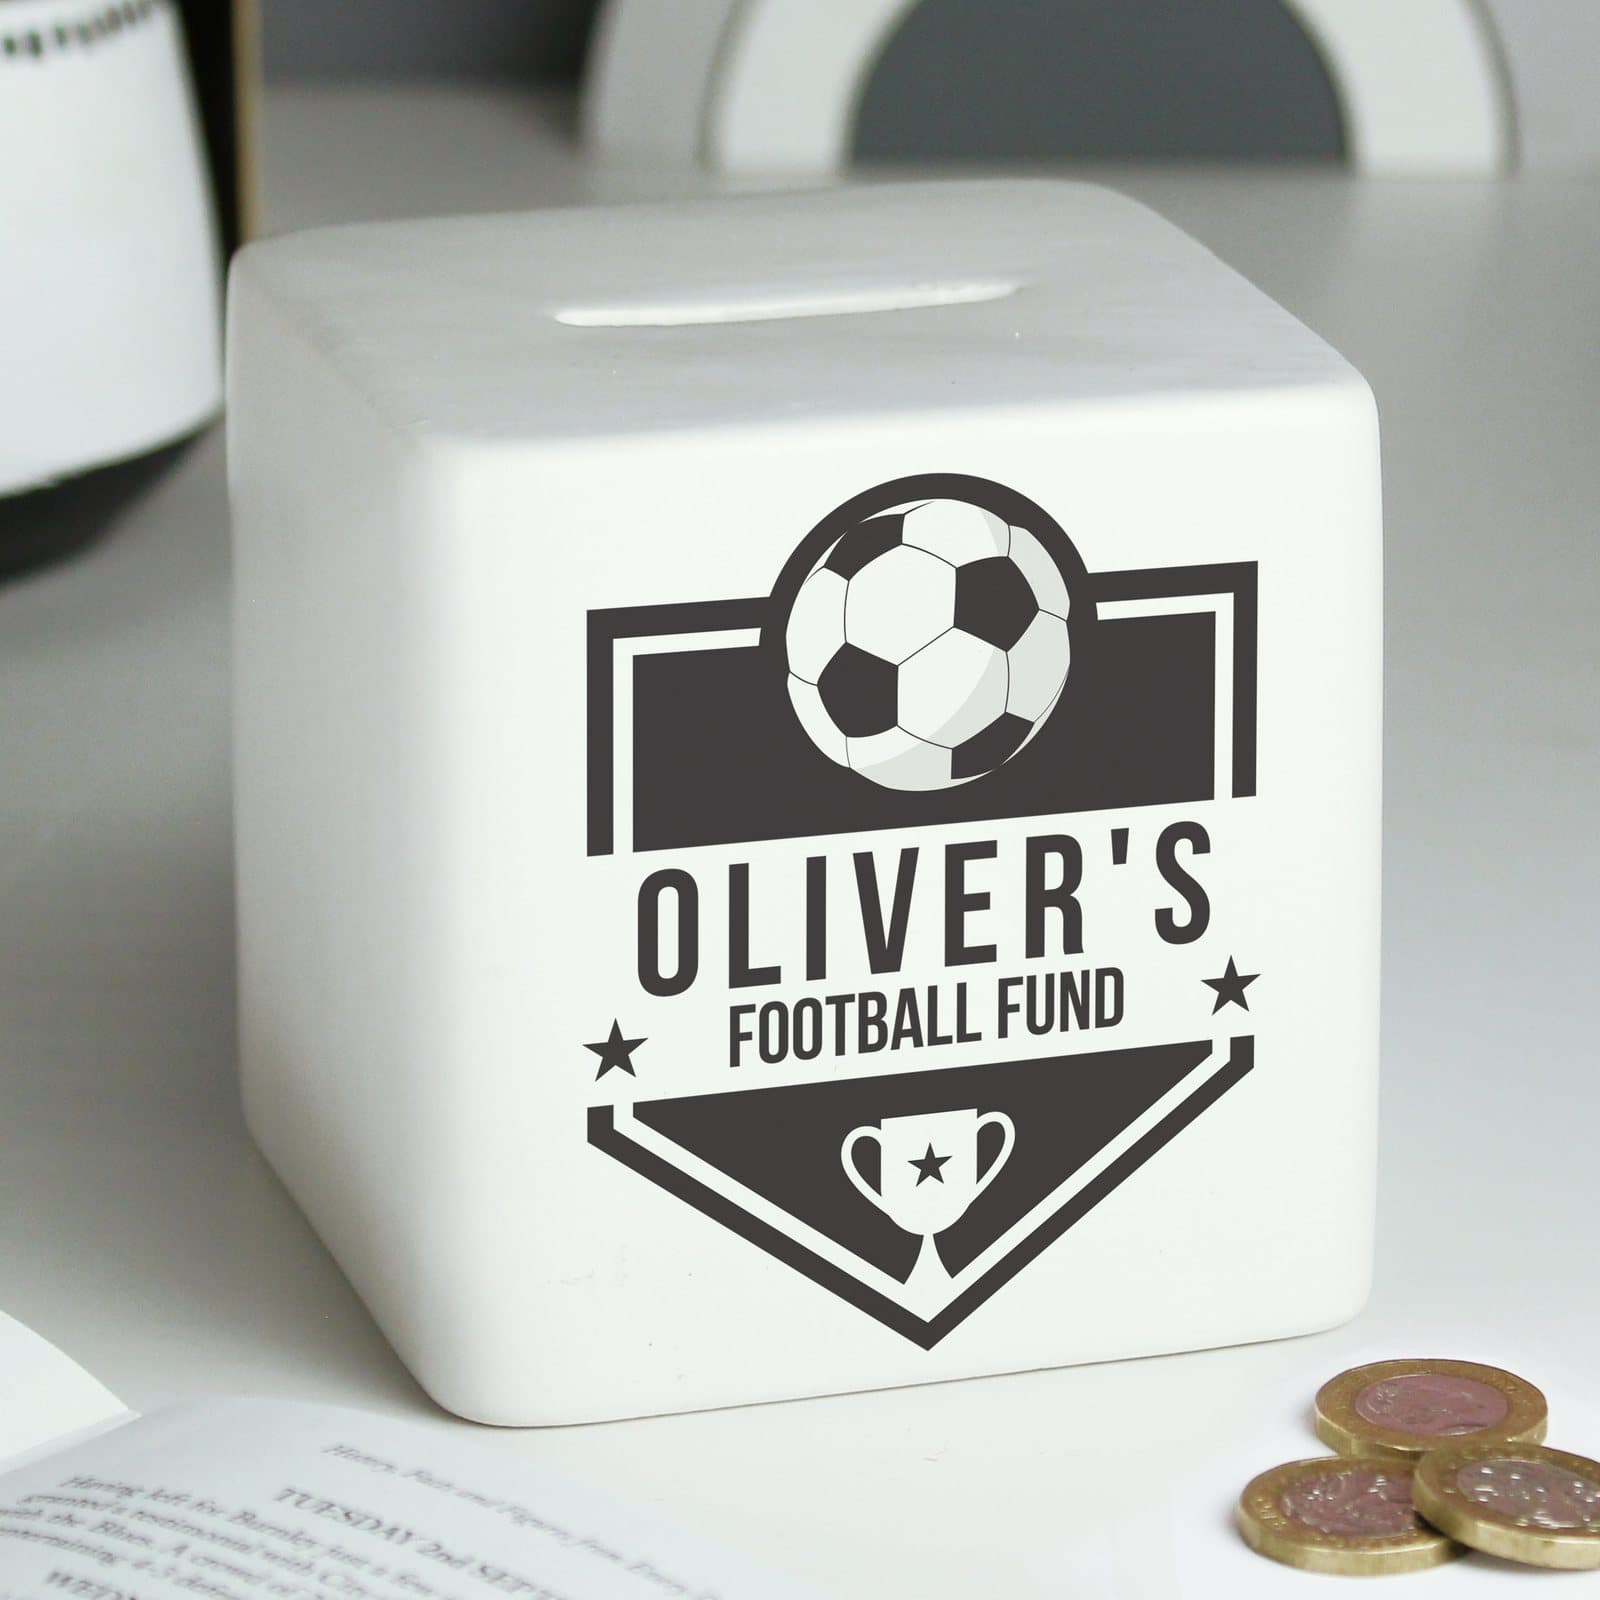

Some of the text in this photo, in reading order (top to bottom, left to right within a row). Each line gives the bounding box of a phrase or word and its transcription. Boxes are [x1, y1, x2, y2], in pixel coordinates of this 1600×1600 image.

[637, 820, 1212, 998] OLIVER'S
[729, 966, 1126, 1069] FOOTBALL FUND
[273, 1485, 416, 1545] TUESDAY
[414, 1541, 476, 1570] 2nd
